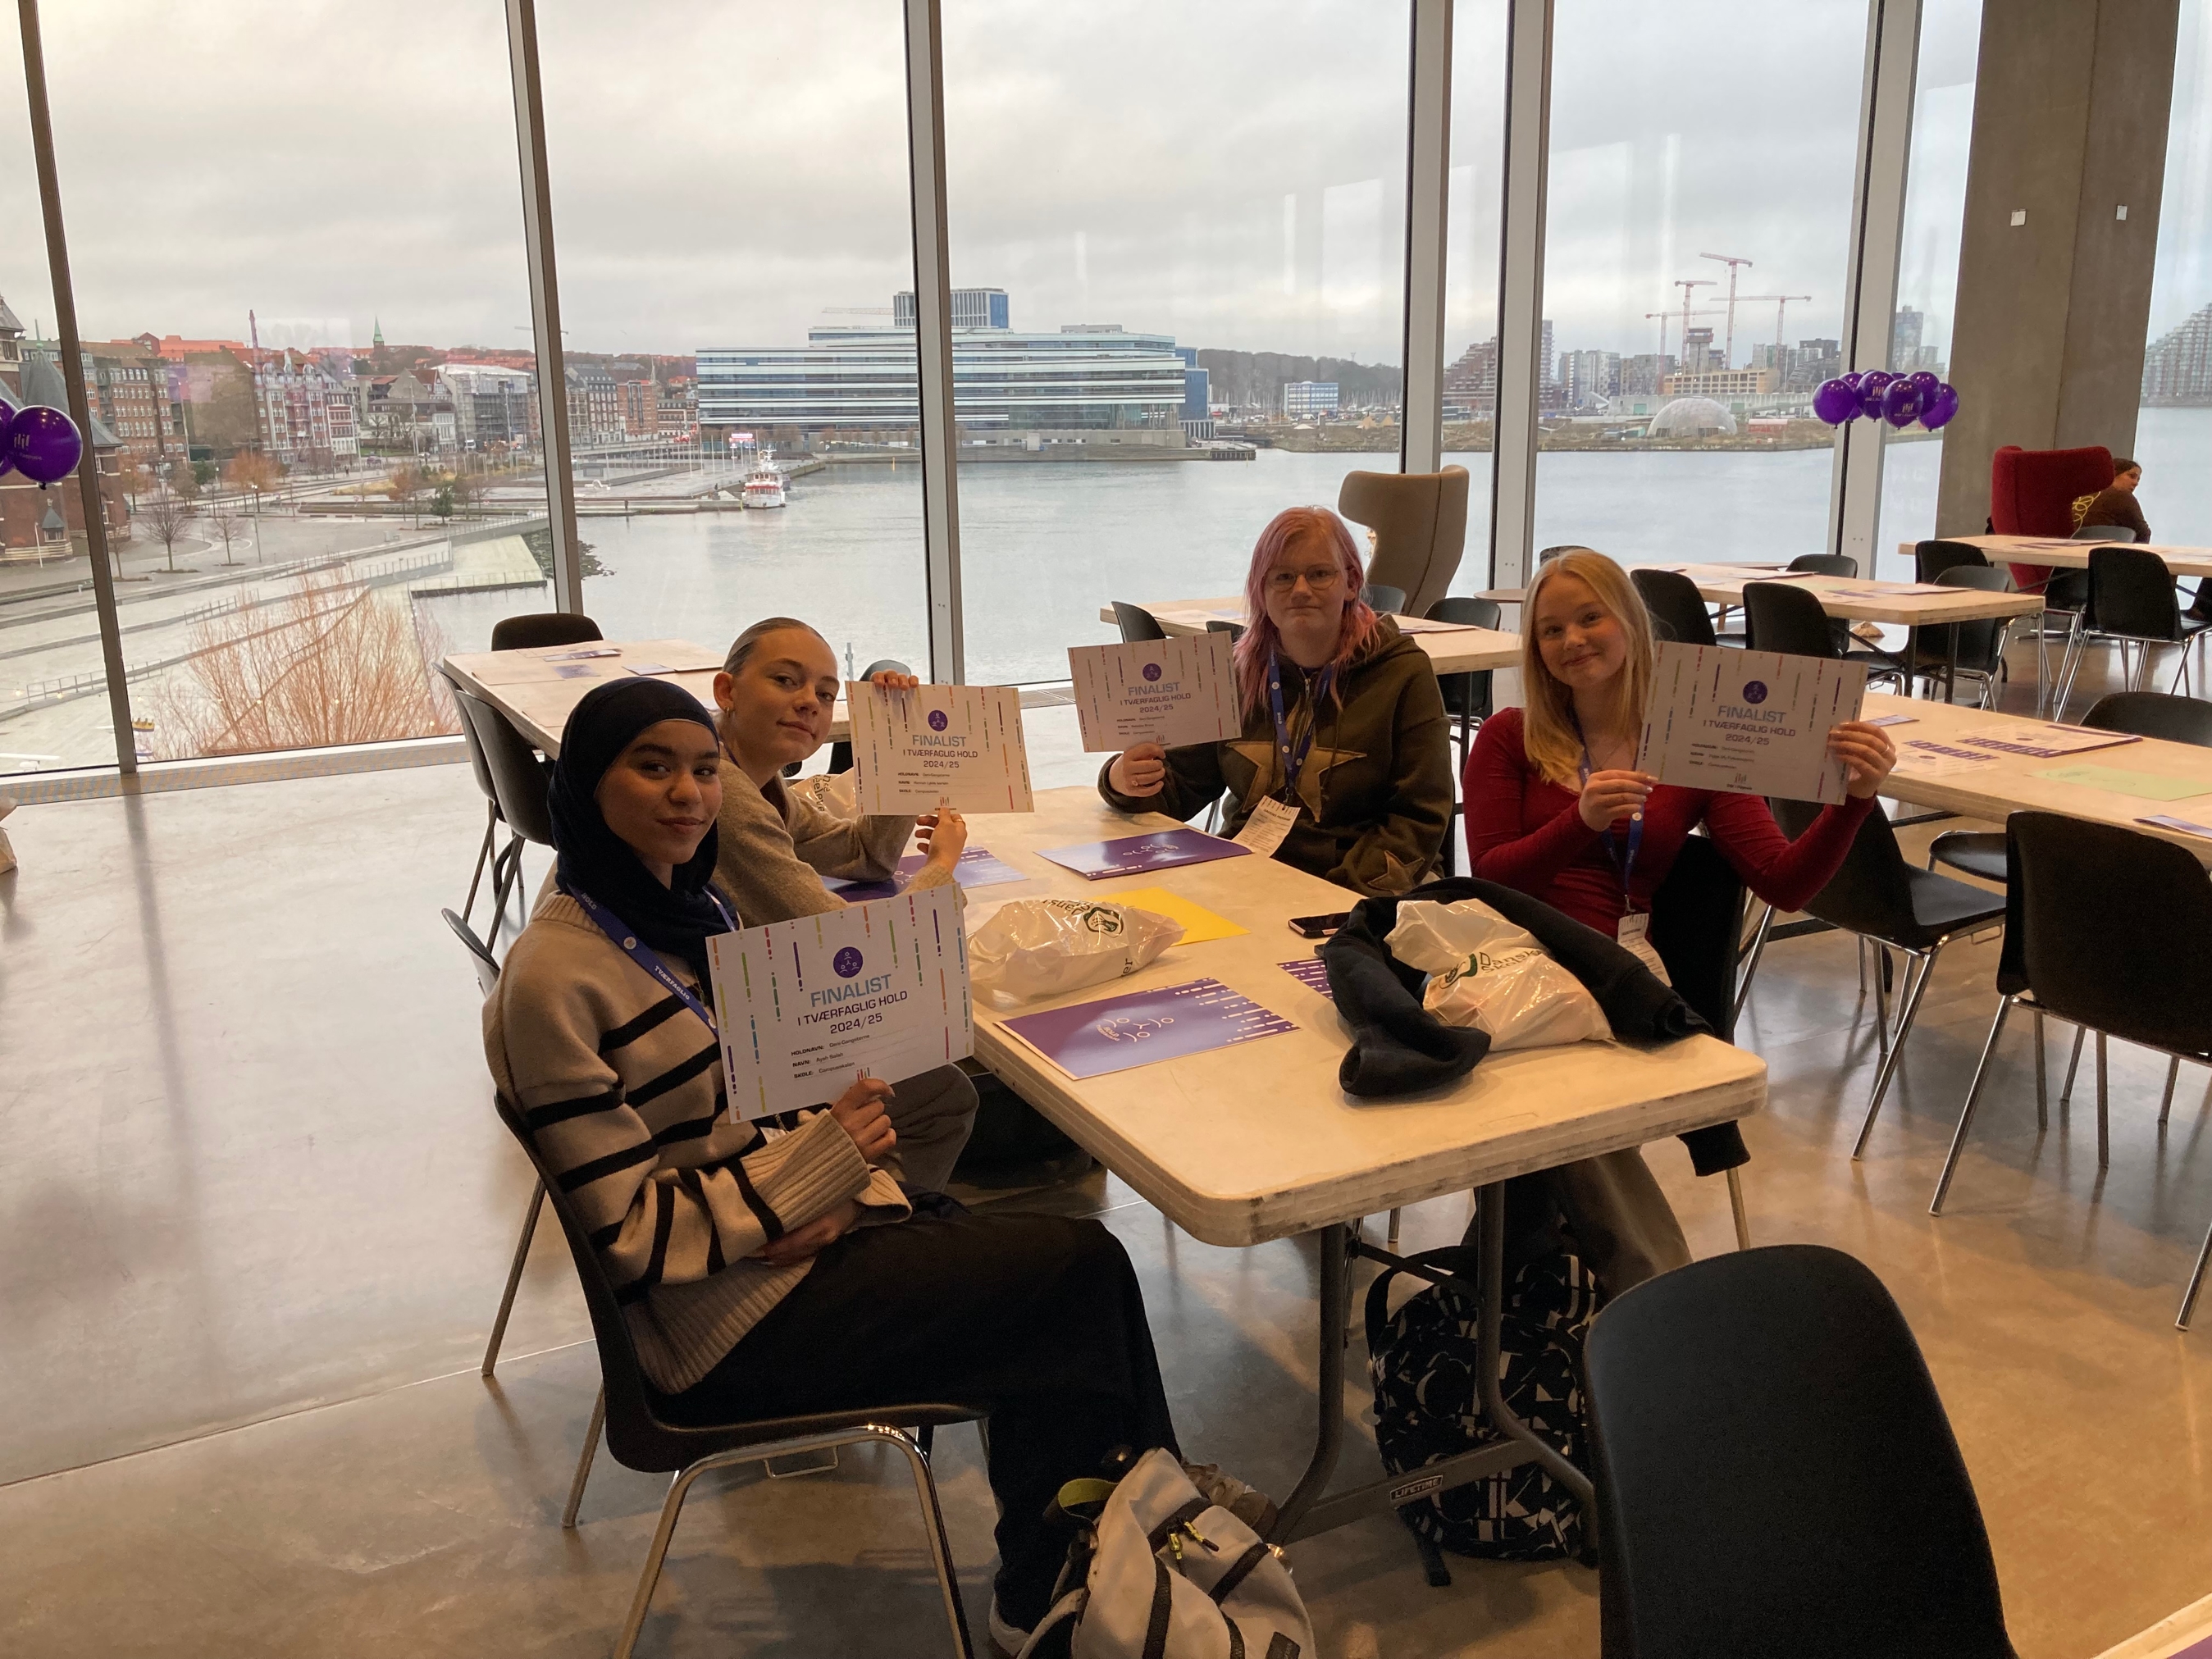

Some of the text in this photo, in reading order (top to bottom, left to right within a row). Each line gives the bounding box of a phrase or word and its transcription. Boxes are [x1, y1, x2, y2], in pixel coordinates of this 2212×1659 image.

[1128, 681, 1181, 696] FINALIST
[1124, 695, 1170, 705] TVÆRFAGLIG
[1171, 692, 1191, 701] HOLD
[1139, 704, 1174, 713] 2024/25
[1717, 704, 1787, 724] FINALIST
[1708, 720, 1767, 734] TVÆRFAGLIG
[1770, 727, 1796, 737] HOLD
[912, 734, 967, 747] FINALIST
[1725, 733, 1770, 745] 2024/25
[907, 750, 955, 758] TVÆRFAGLIG
[923, 760, 960, 769] 2024/25
[810, 973, 892, 1008] FINALIST
[797, 990, 908, 1026] I TVÆRFAGLIG HOLD
[829, 1012, 883, 1035] 2024/25
[791, 1045, 825, 1056] HOLDNAVN:
[792, 1059, 812, 1068] NAVN:
